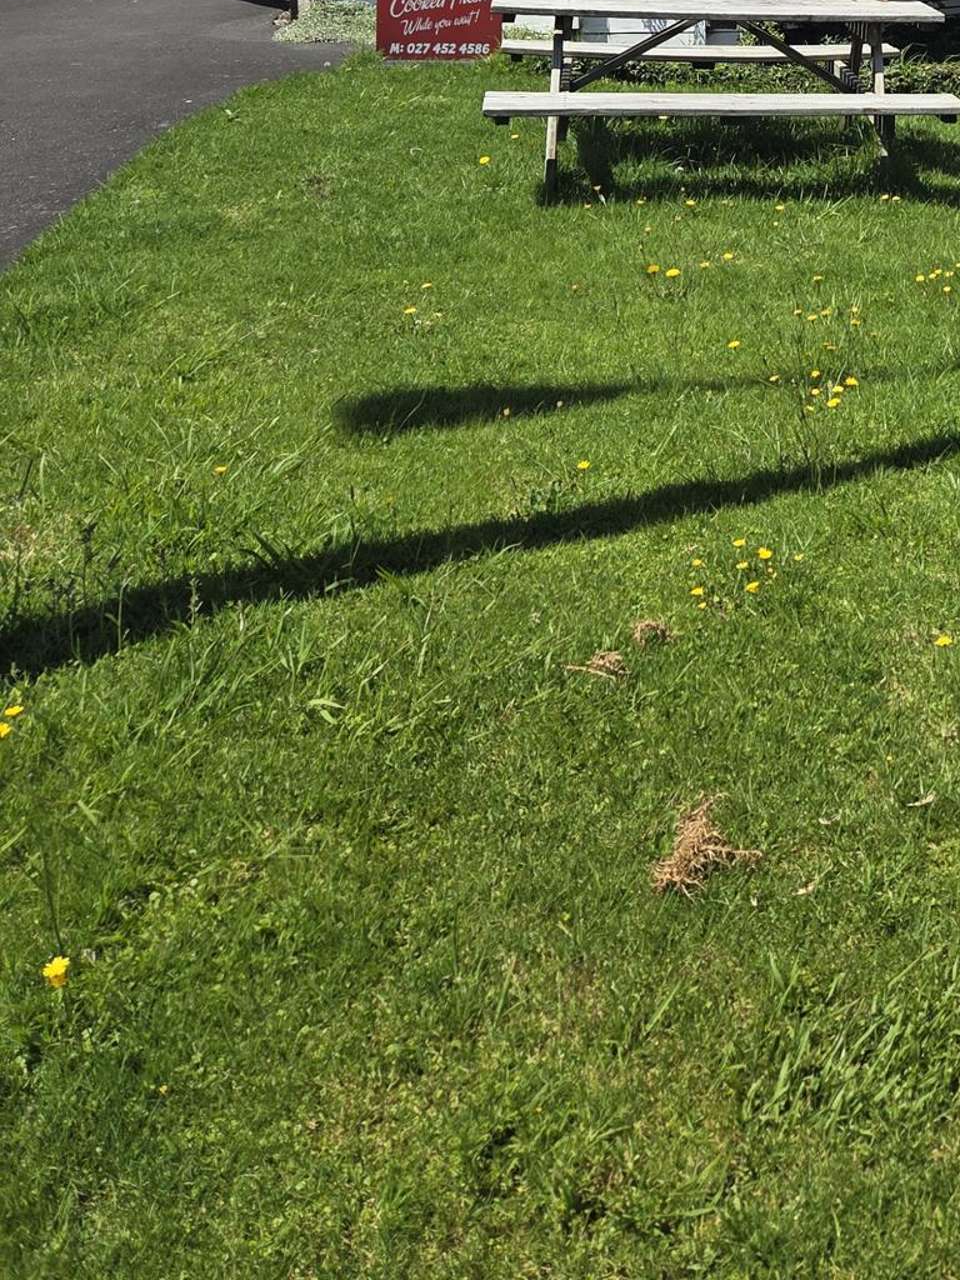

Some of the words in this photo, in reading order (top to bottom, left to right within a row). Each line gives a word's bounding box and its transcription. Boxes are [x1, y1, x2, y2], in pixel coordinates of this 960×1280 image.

[401, 19, 432, 36] While
[434, 20, 451, 36] you
[407, 43, 431, 55] 027
[432, 43, 456, 55] 452
[459, 43, 490, 55] 4586
